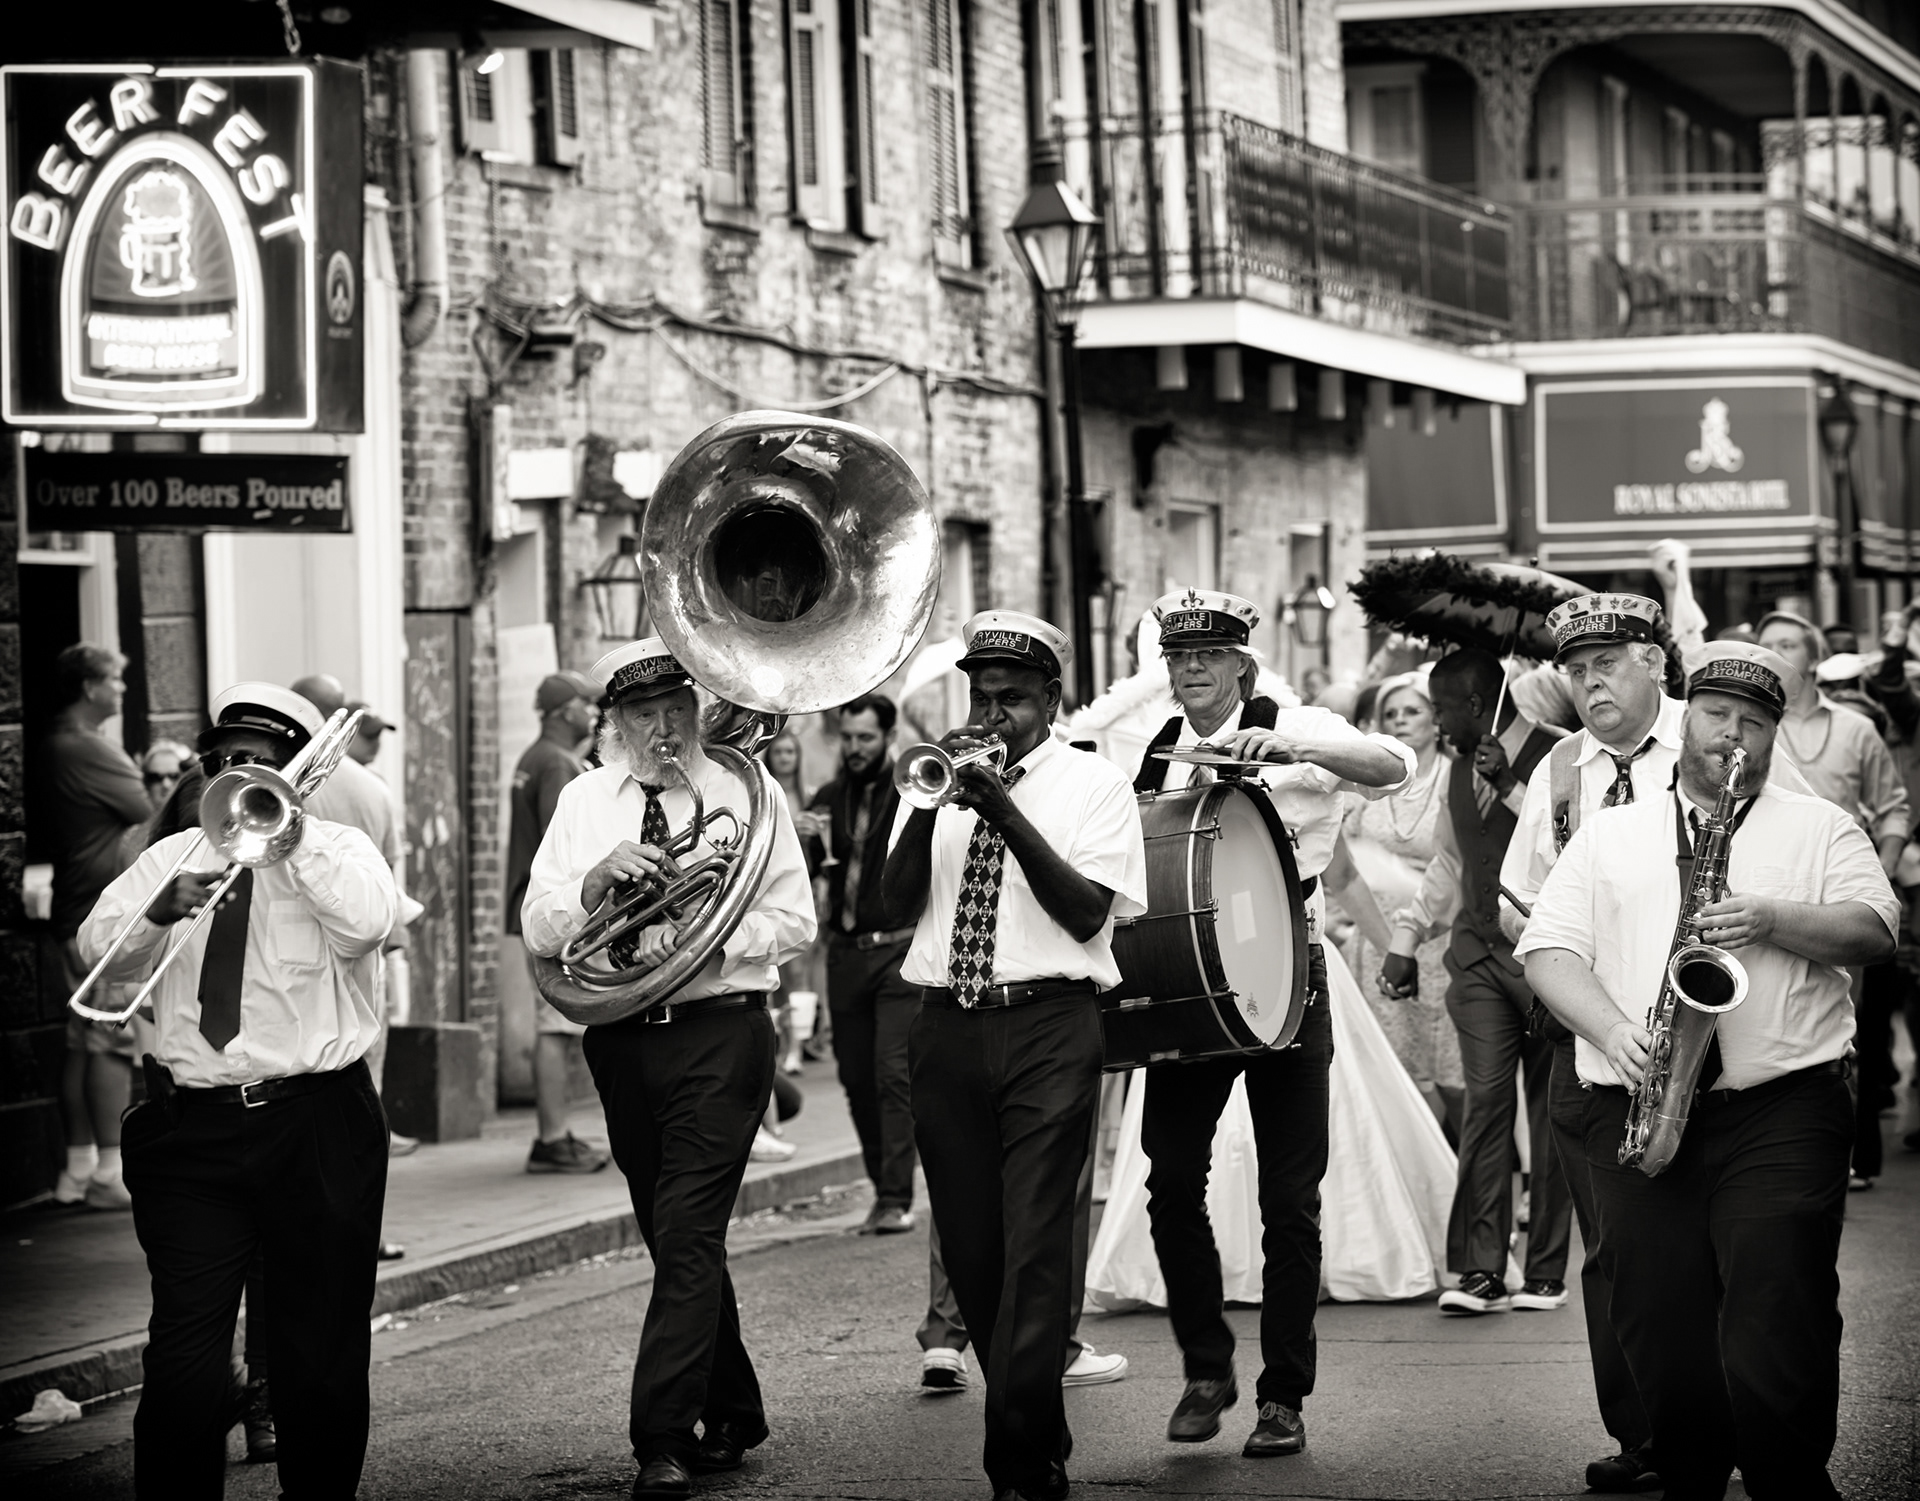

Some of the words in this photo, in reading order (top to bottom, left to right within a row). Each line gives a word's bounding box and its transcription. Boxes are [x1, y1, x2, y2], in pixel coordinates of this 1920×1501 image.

[10, 78, 160, 251] BEER
[177, 78, 312, 242] FEST
[37, 479, 100, 508] Over
[109, 479, 158, 508] 100
[165, 477, 240, 508] Beers
[246, 478, 343, 510] Poured
[617, 655, 677, 679] STORYVILLE
[622, 664, 675, 685] STOMPERS
[1712, 660, 1776, 684] STORYVILLE
[1712, 668, 1771, 689] STOMPERS
